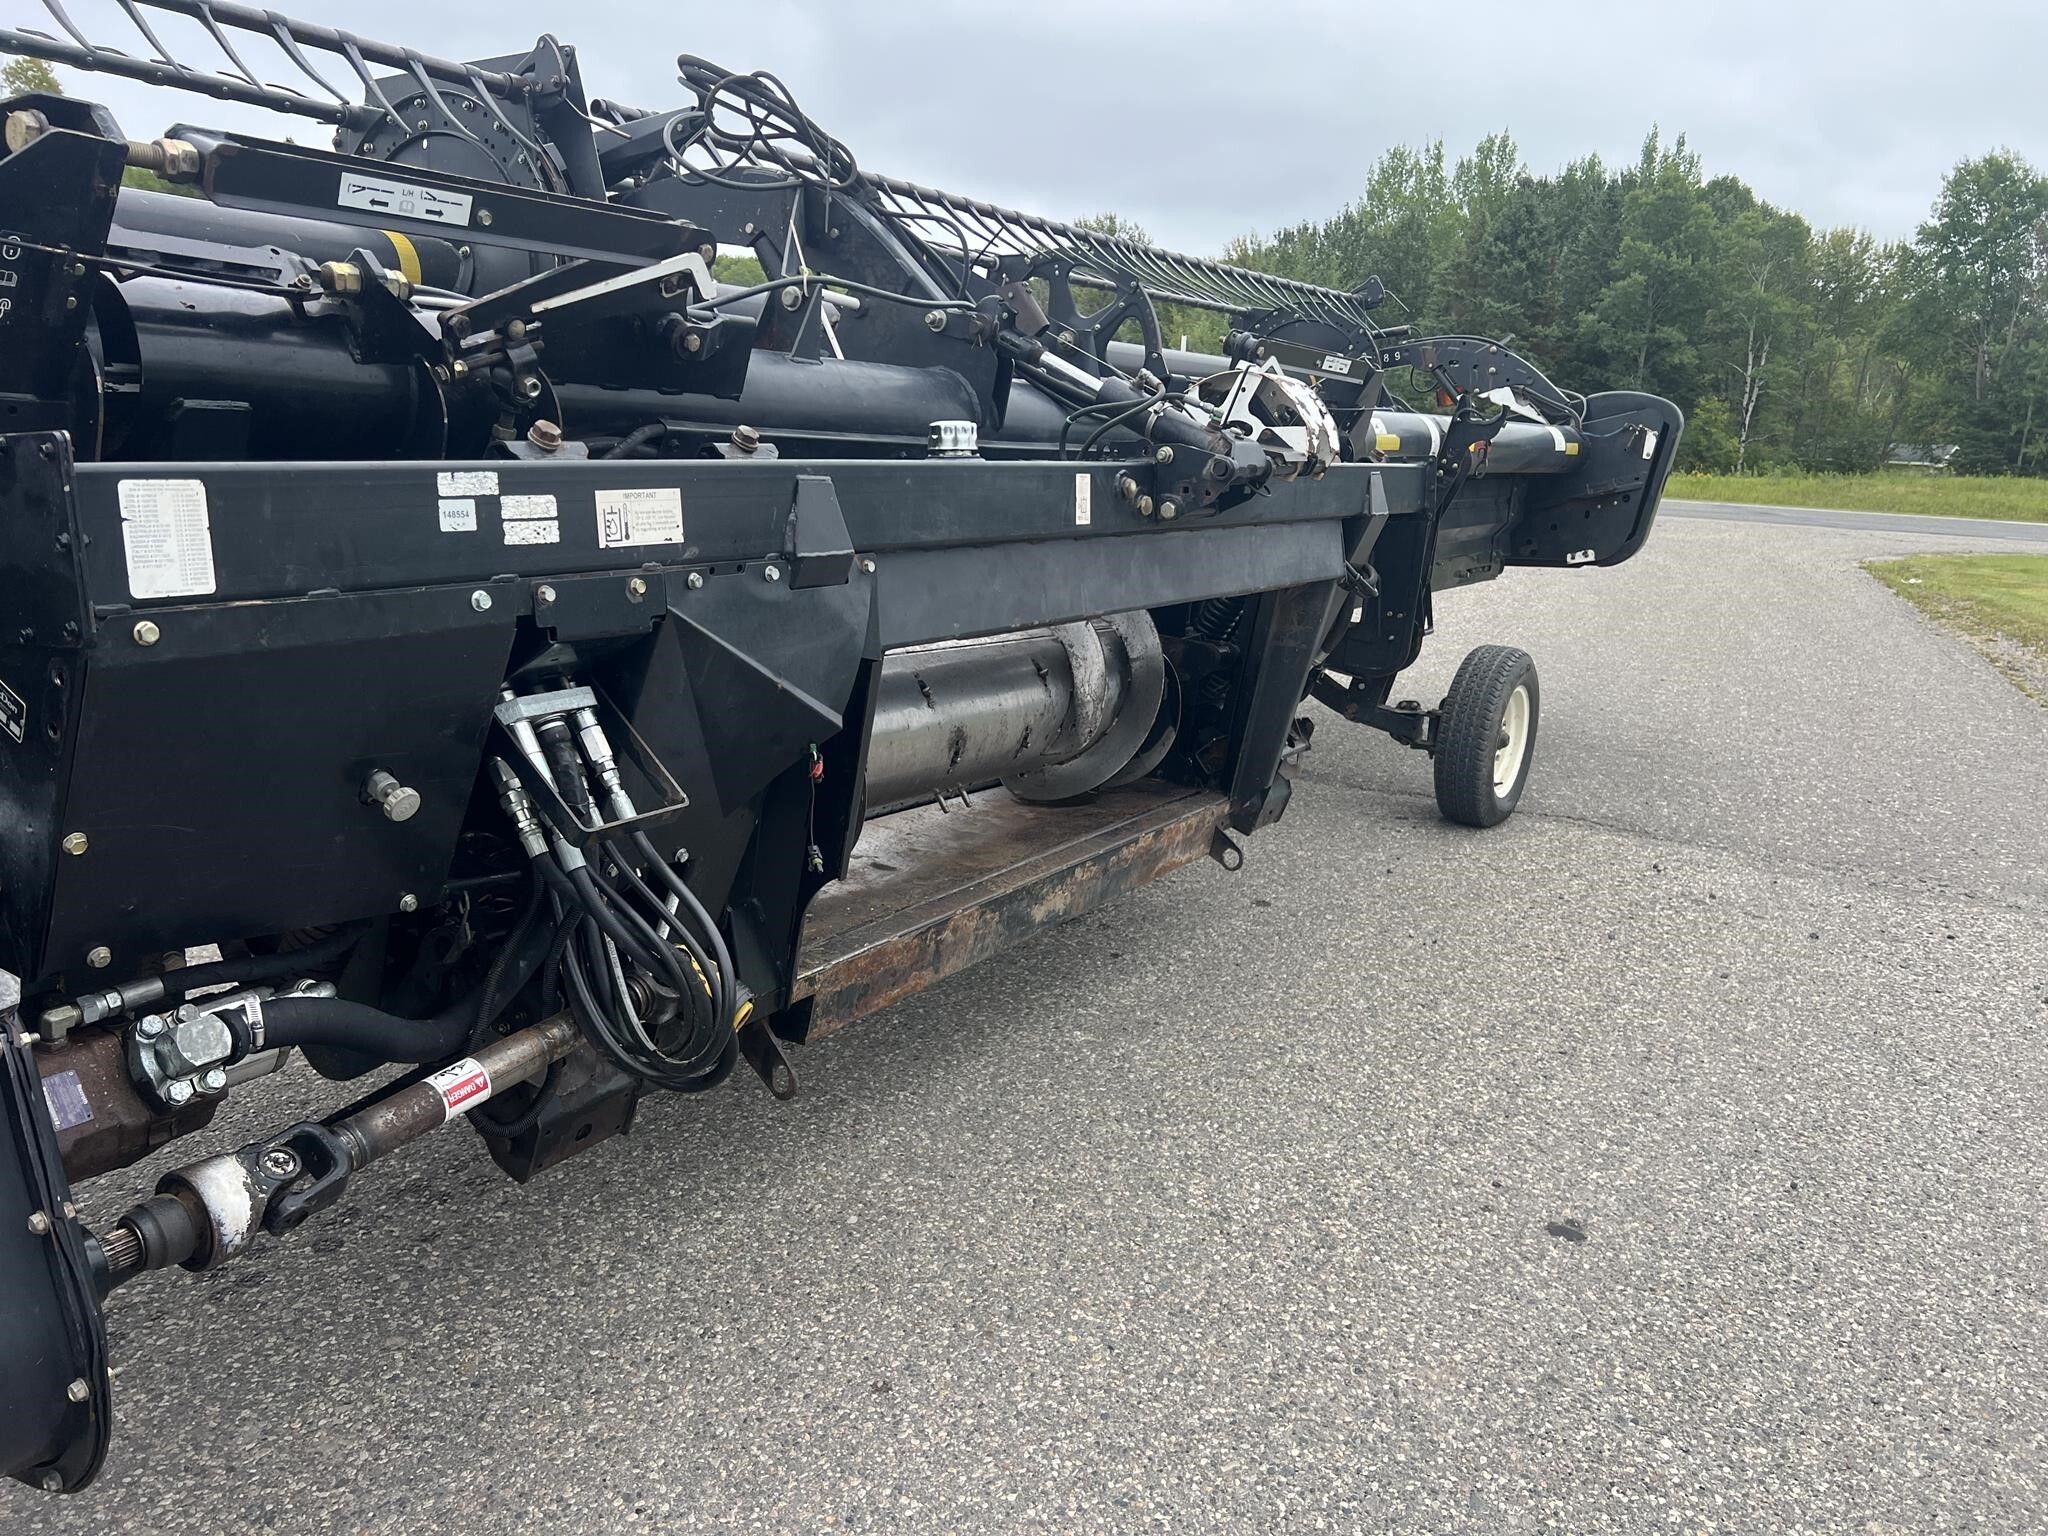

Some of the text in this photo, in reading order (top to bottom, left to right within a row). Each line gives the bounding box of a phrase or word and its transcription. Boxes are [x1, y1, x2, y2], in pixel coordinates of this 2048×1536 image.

[402, 188, 414, 198] L/H
[1383, 351, 1401, 362] 8 9
[623, 491, 657, 499] IMPORTANT
[443, 510, 470, 518] 148554
[448, 1082, 477, 1103] DANGER
